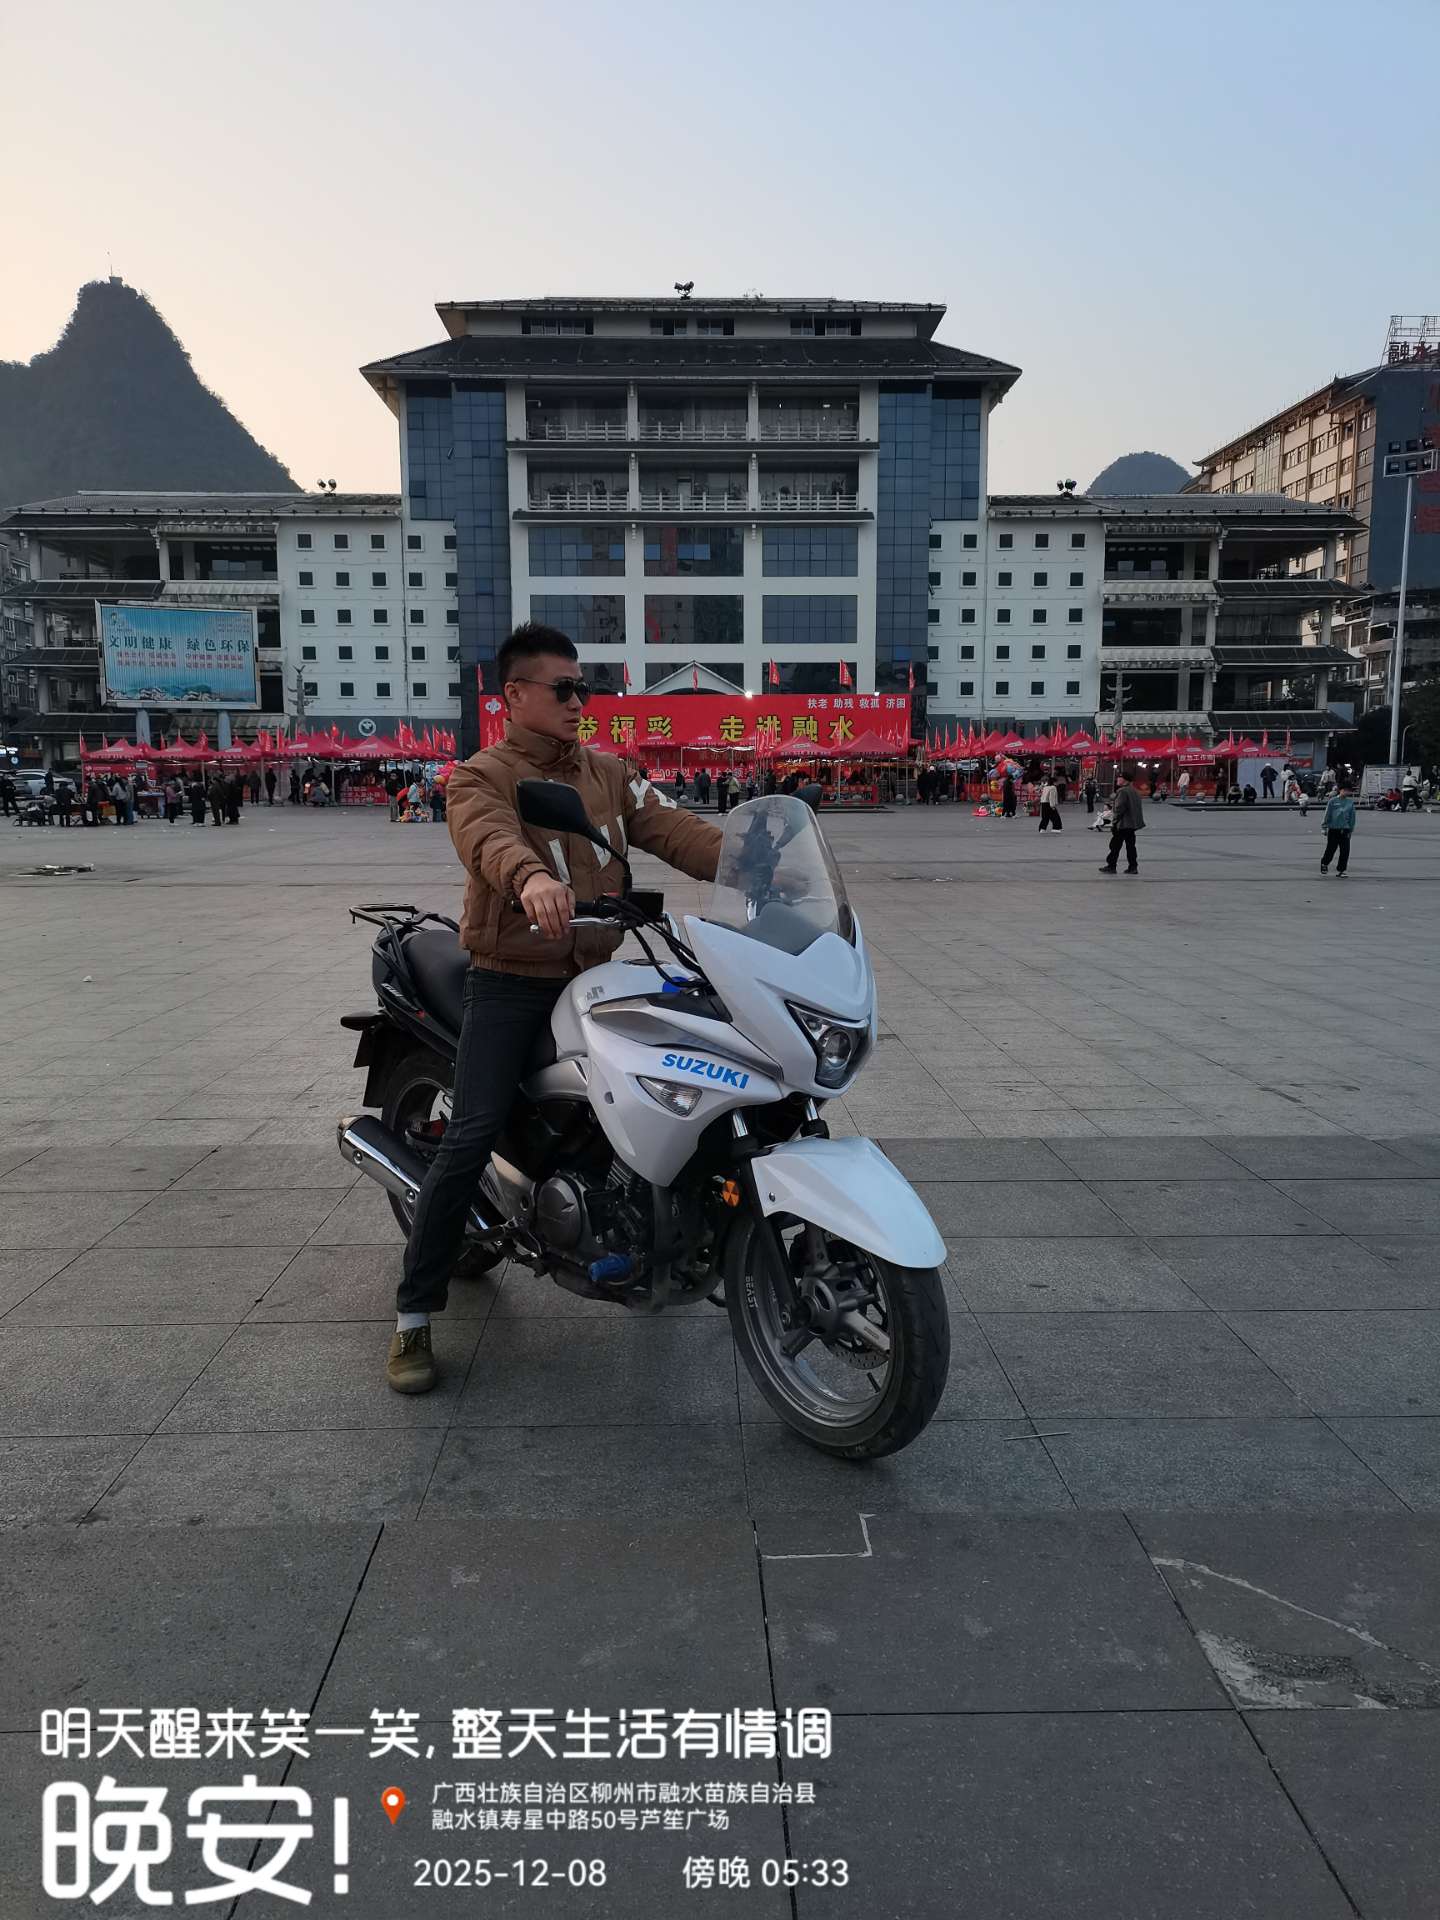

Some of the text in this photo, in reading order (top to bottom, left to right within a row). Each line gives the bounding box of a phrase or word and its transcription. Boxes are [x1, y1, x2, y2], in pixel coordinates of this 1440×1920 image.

[1389, 341, 1440, 363] 融水
[108, 635, 250, 653] 文明健康 绿色环保
[807, 697, 828, 709] 扶老
[833, 697, 854, 709] 助残
[719, 715, 857, 743] 走进融水
[662, 1053, 749, 1089] SUZUKI
